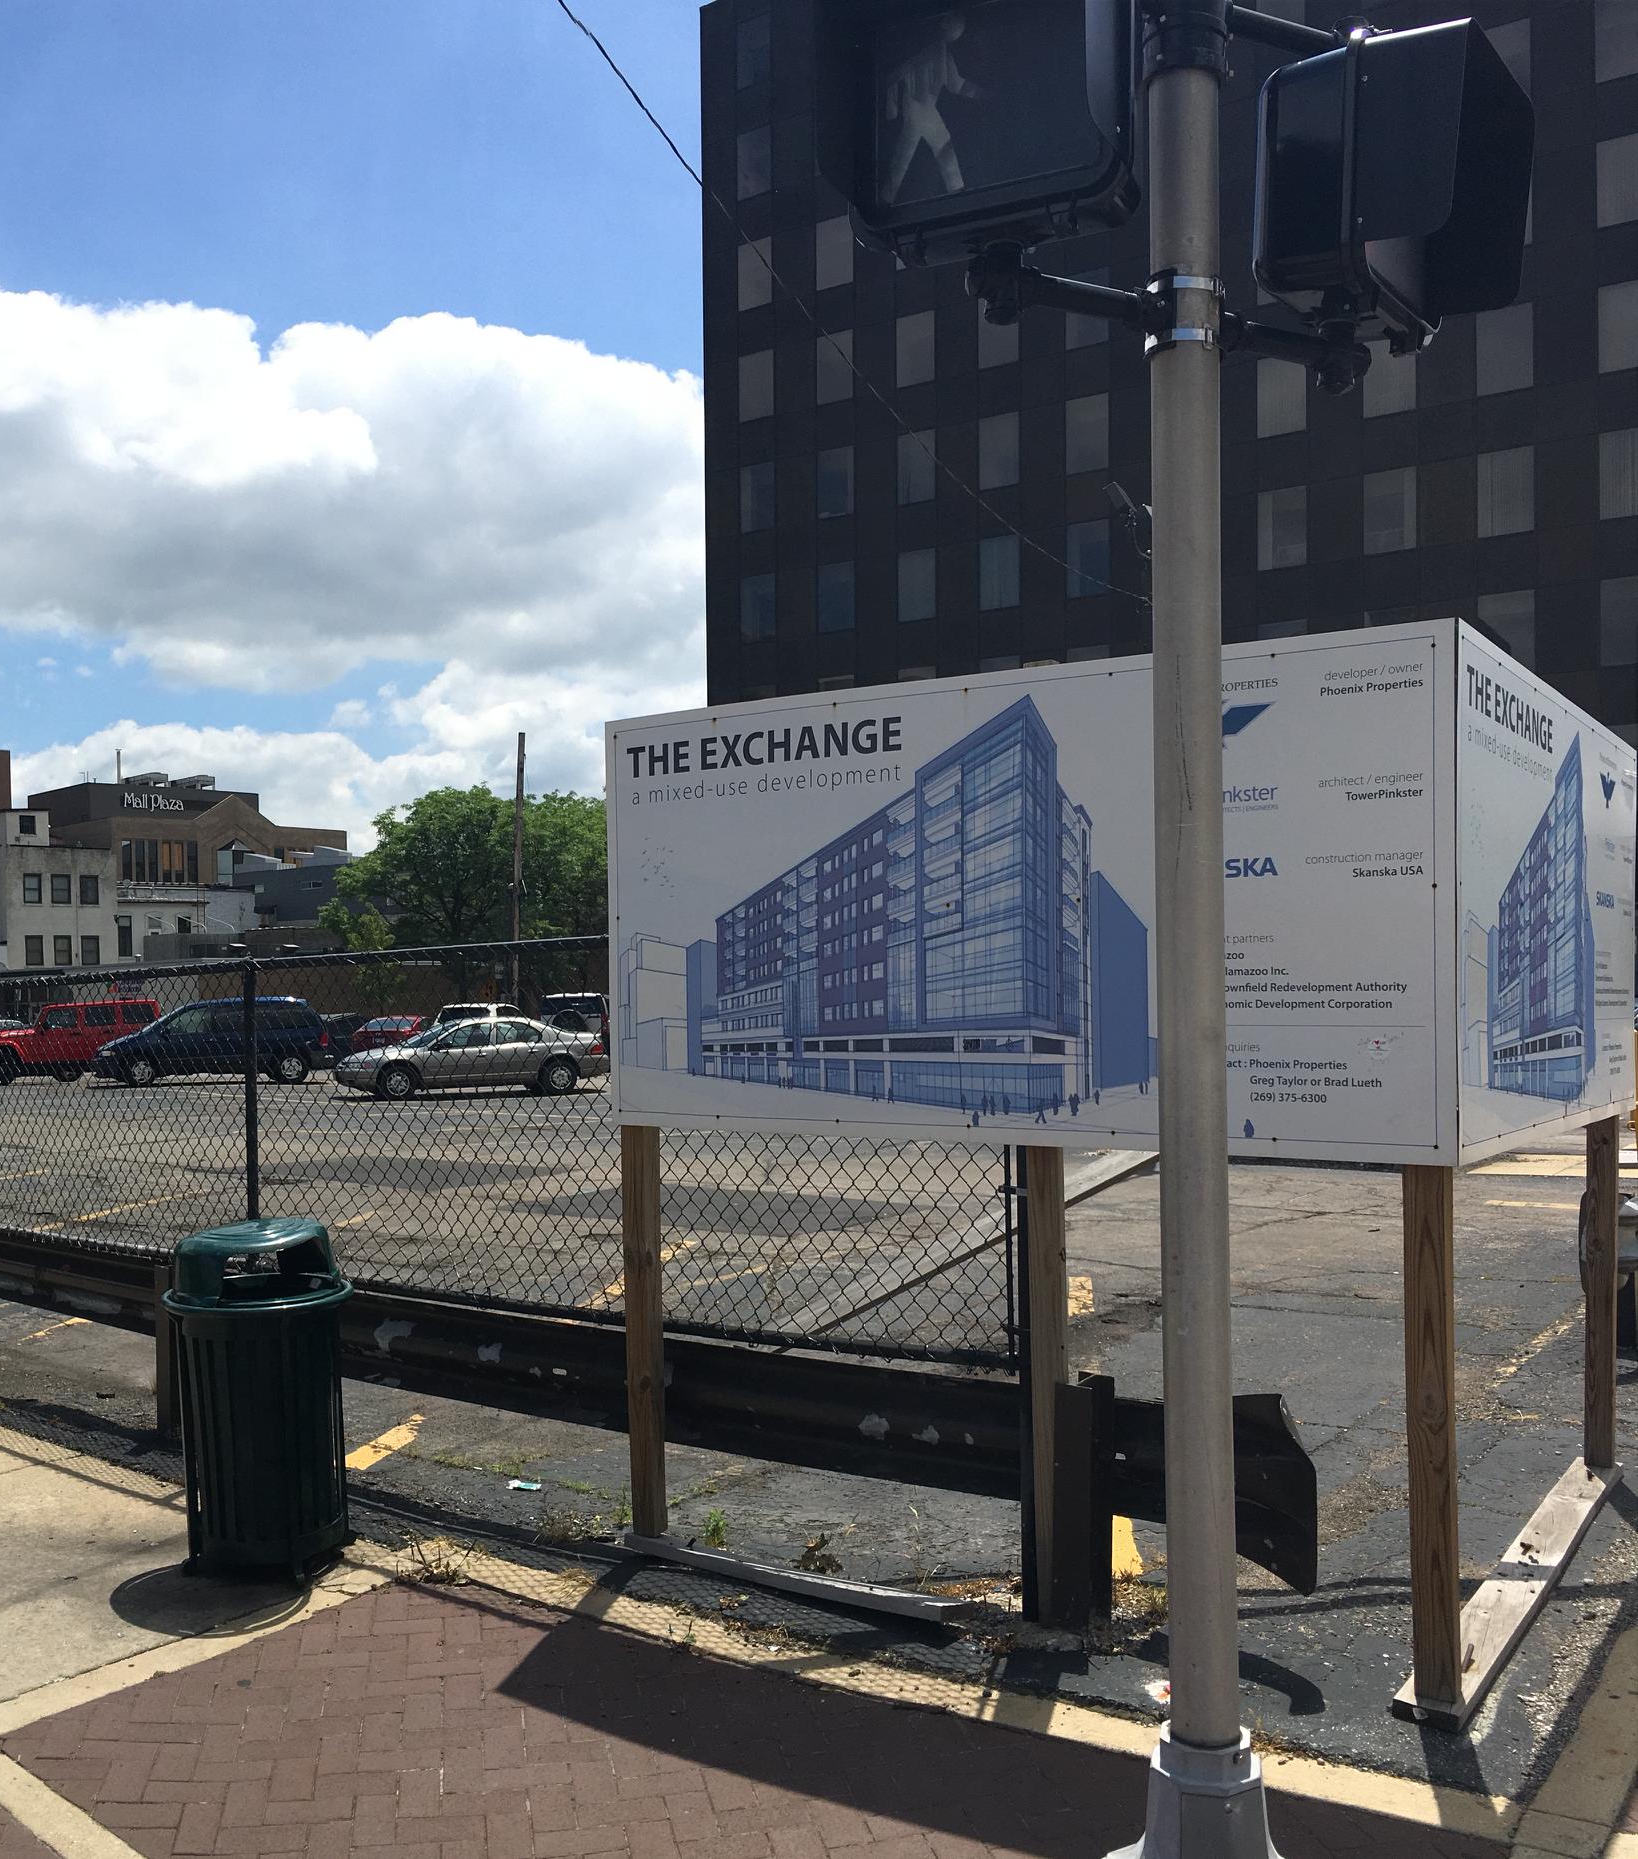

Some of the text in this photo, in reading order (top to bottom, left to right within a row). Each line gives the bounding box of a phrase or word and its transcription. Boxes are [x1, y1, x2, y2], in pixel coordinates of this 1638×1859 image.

[1324, 668, 1379, 681] developer
[1388, 662, 1424, 674] owner
[1222, 678, 1279, 692] ROPERTIES
[1319, 678, 1424, 696] Phoenix Properties
[1466, 664, 1553, 754] THE EXCHANGE
[626, 716, 902, 778] THE EXCHANGE
[631, 763, 902, 805] a mixed-use development
[1319, 776, 1364, 788] architect
[1374, 771, 1424, 785] engineer
[1345, 788, 1424, 801] TowerPinkster
[124, 792, 184, 812] Mall Plaza
[1304, 850, 1424, 865] construction manager
[1352, 866, 1424, 878] Skanska USA
[1232, 935, 1276, 946] partners
[1224, 966, 1290, 976] lamazoo Inc.
[1225, 981, 1408, 994] ownfield Redevelopment Authority
[1255, 999, 1326, 1011] Development
[1327, 999, 1393, 1011] Corporation
[1226, 1044, 1261, 1053] quiries
[1249, 1059, 1291, 1070] Phoenix
[1293, 1060, 1348, 1072] Properties
[1249, 1075, 1383, 1088] Greg Taylor or Brad Lueth
[1249, 1092, 1328, 1104] (269) 375-6300
